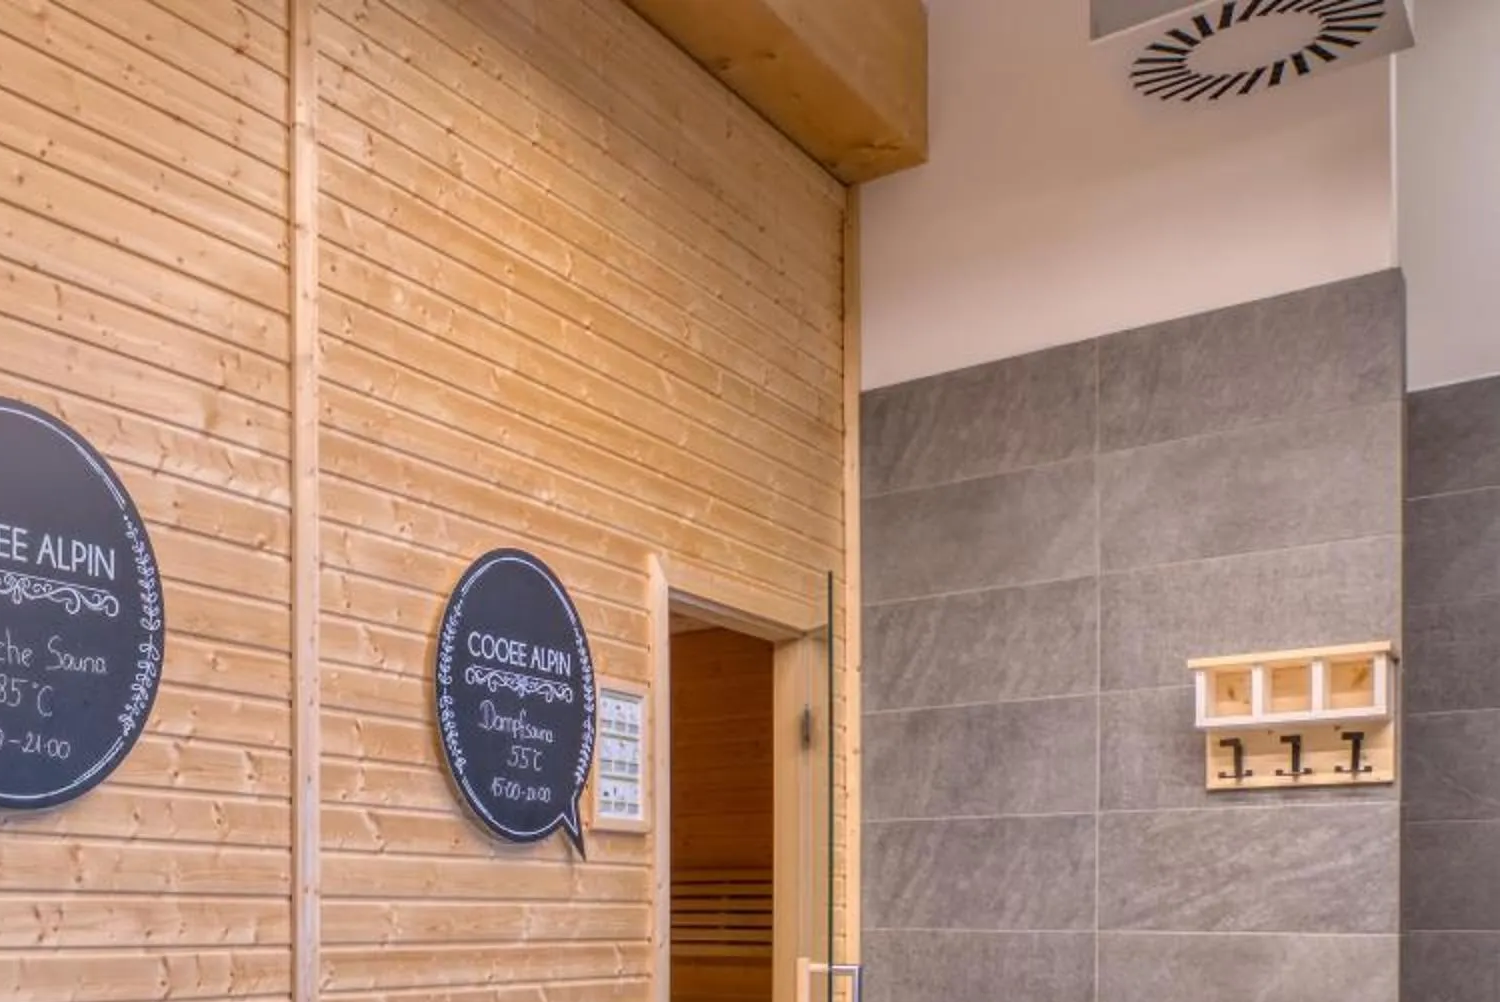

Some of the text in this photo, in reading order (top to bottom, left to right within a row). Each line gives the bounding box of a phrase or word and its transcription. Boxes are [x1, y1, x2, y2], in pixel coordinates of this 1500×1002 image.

[36, 532, 116, 581] ALPIN
[46, 634, 107, 675] Sauna
[467, 630, 572, 677] COOEE ALPIN
